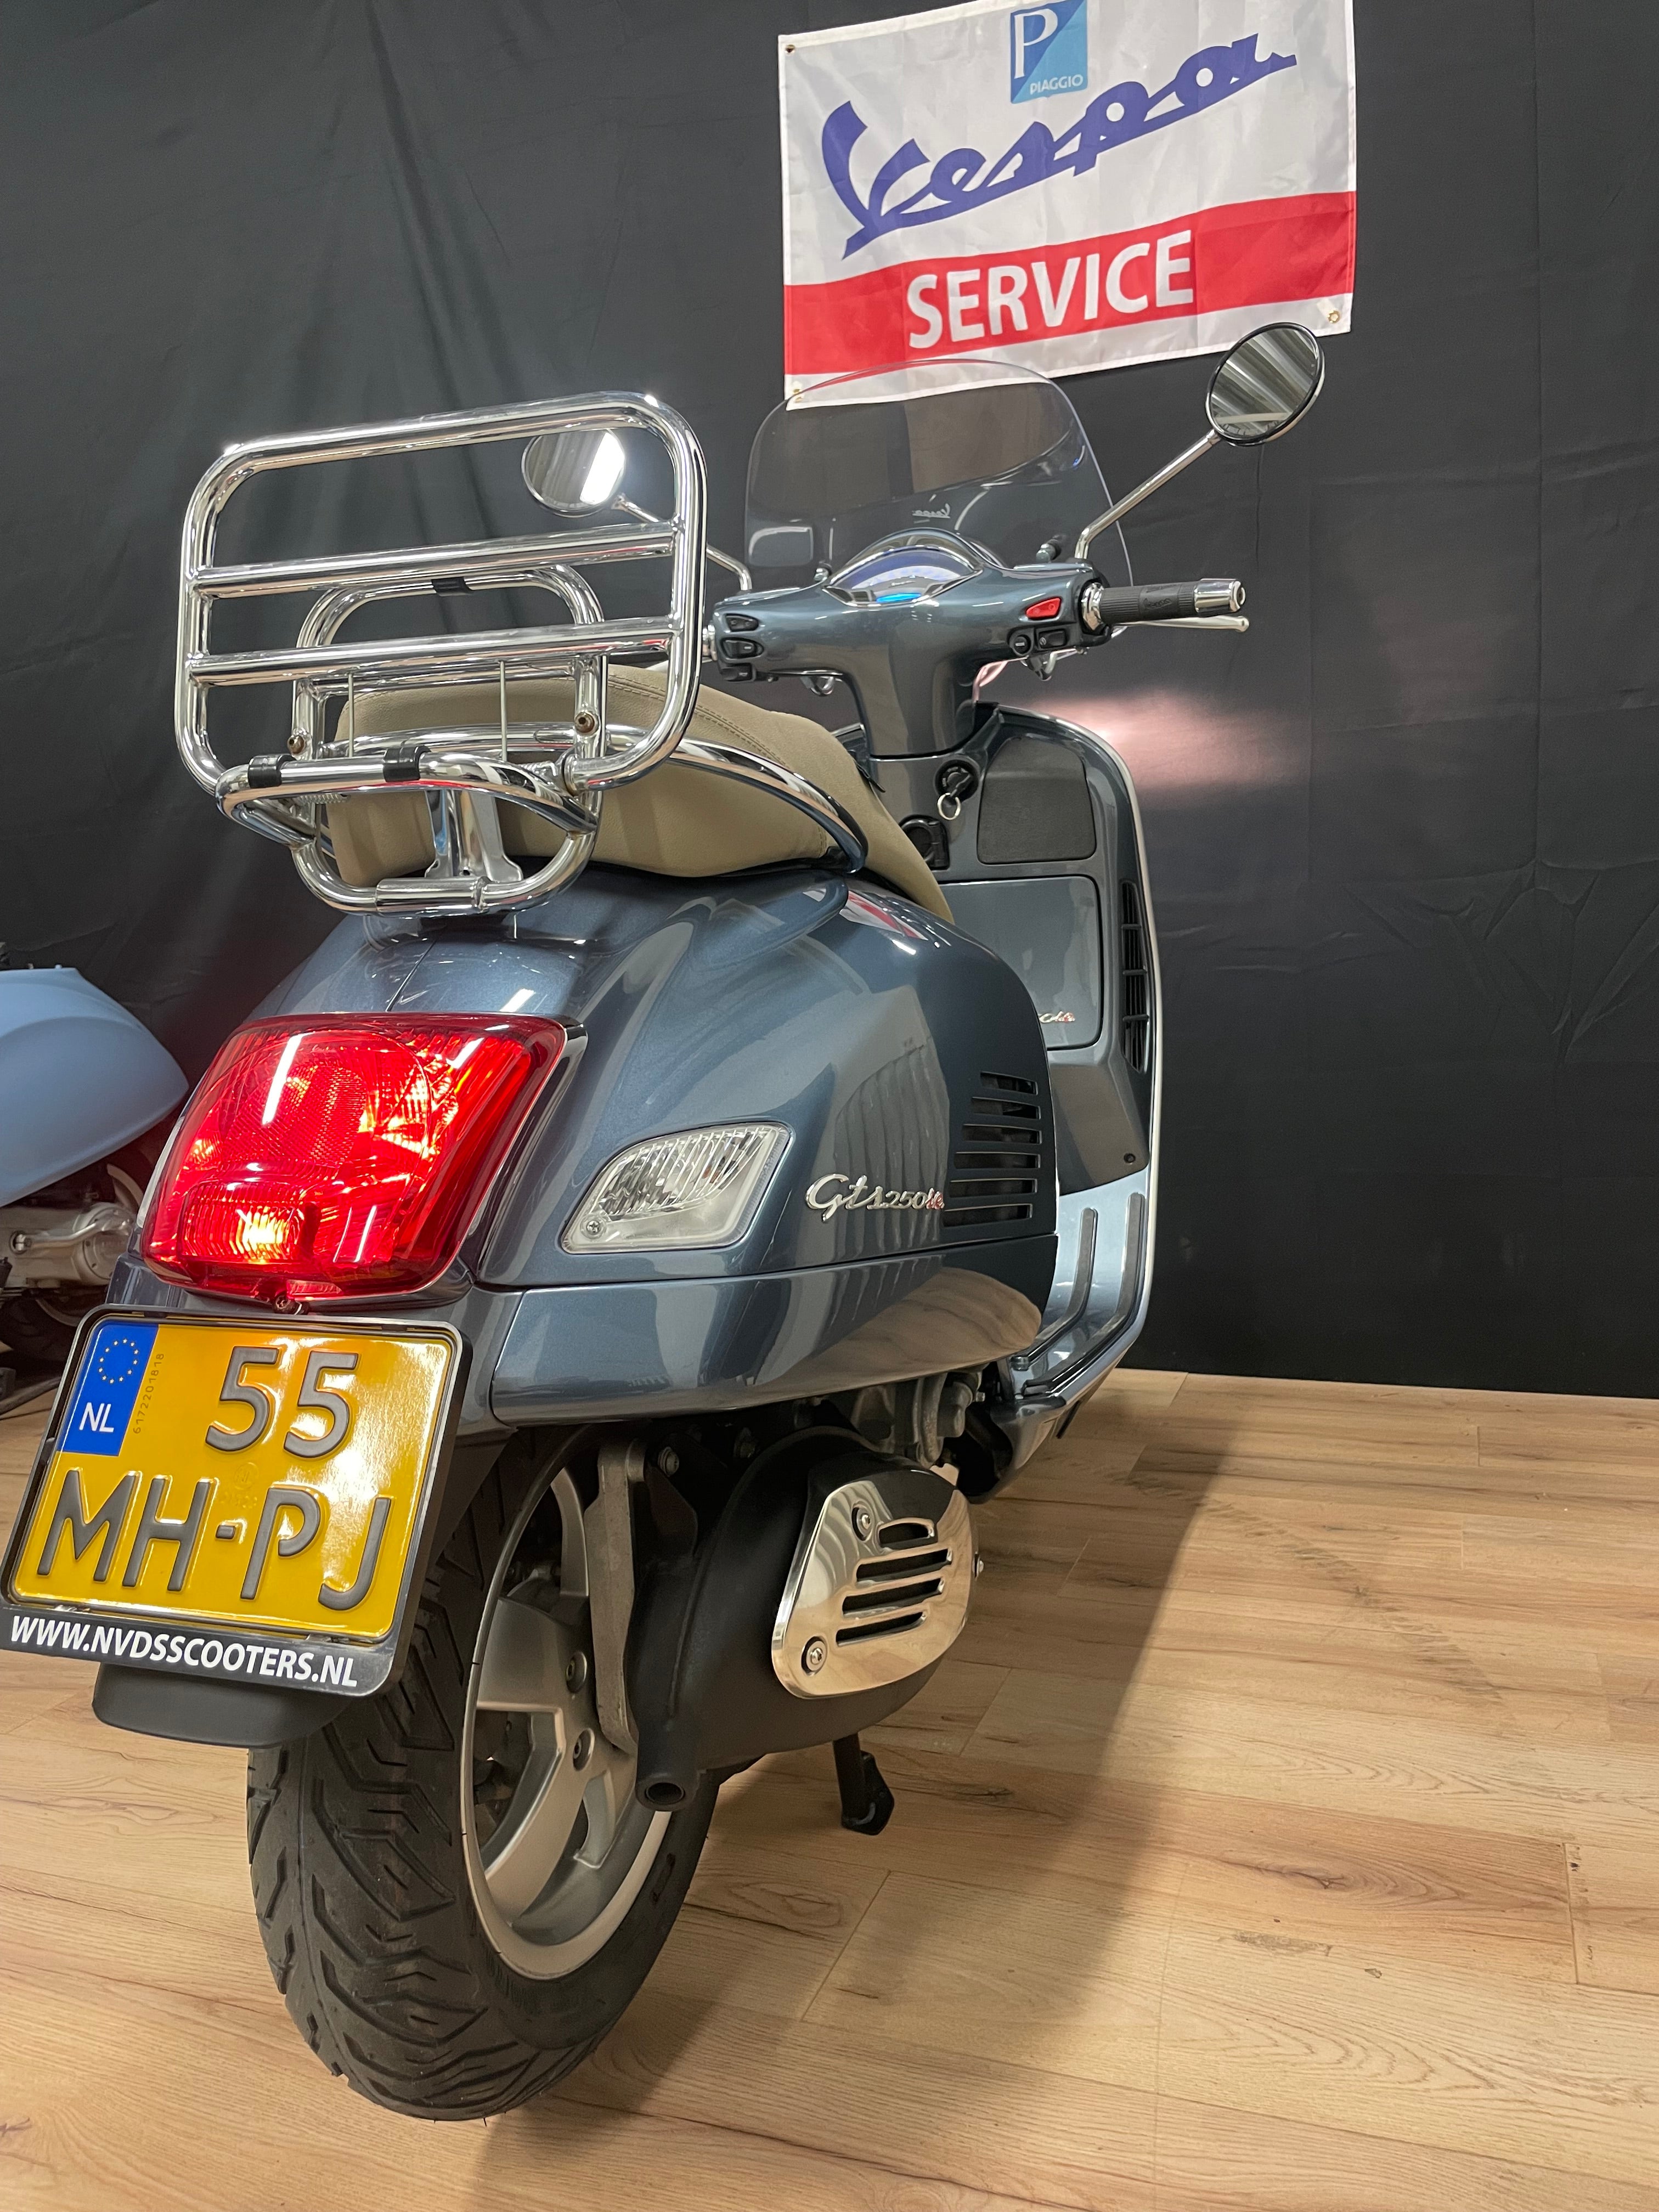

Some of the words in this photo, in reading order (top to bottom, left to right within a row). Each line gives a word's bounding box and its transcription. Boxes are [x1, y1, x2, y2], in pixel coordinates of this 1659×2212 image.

[1029, 74, 1084, 95] PIAGGIO
[821, 33, 1296, 261] Vespa
[907, 229, 1194, 349] SERVICE
[78, 1402, 115, 1434] NL
[133, 1353, 165, 1435] 6172201818
[205, 1345, 359, 1459] 55
[36, 1470, 391, 1611] MH-PJ
[10, 1615, 358, 1688] WWW.NVDSSCOOTERS.NL
